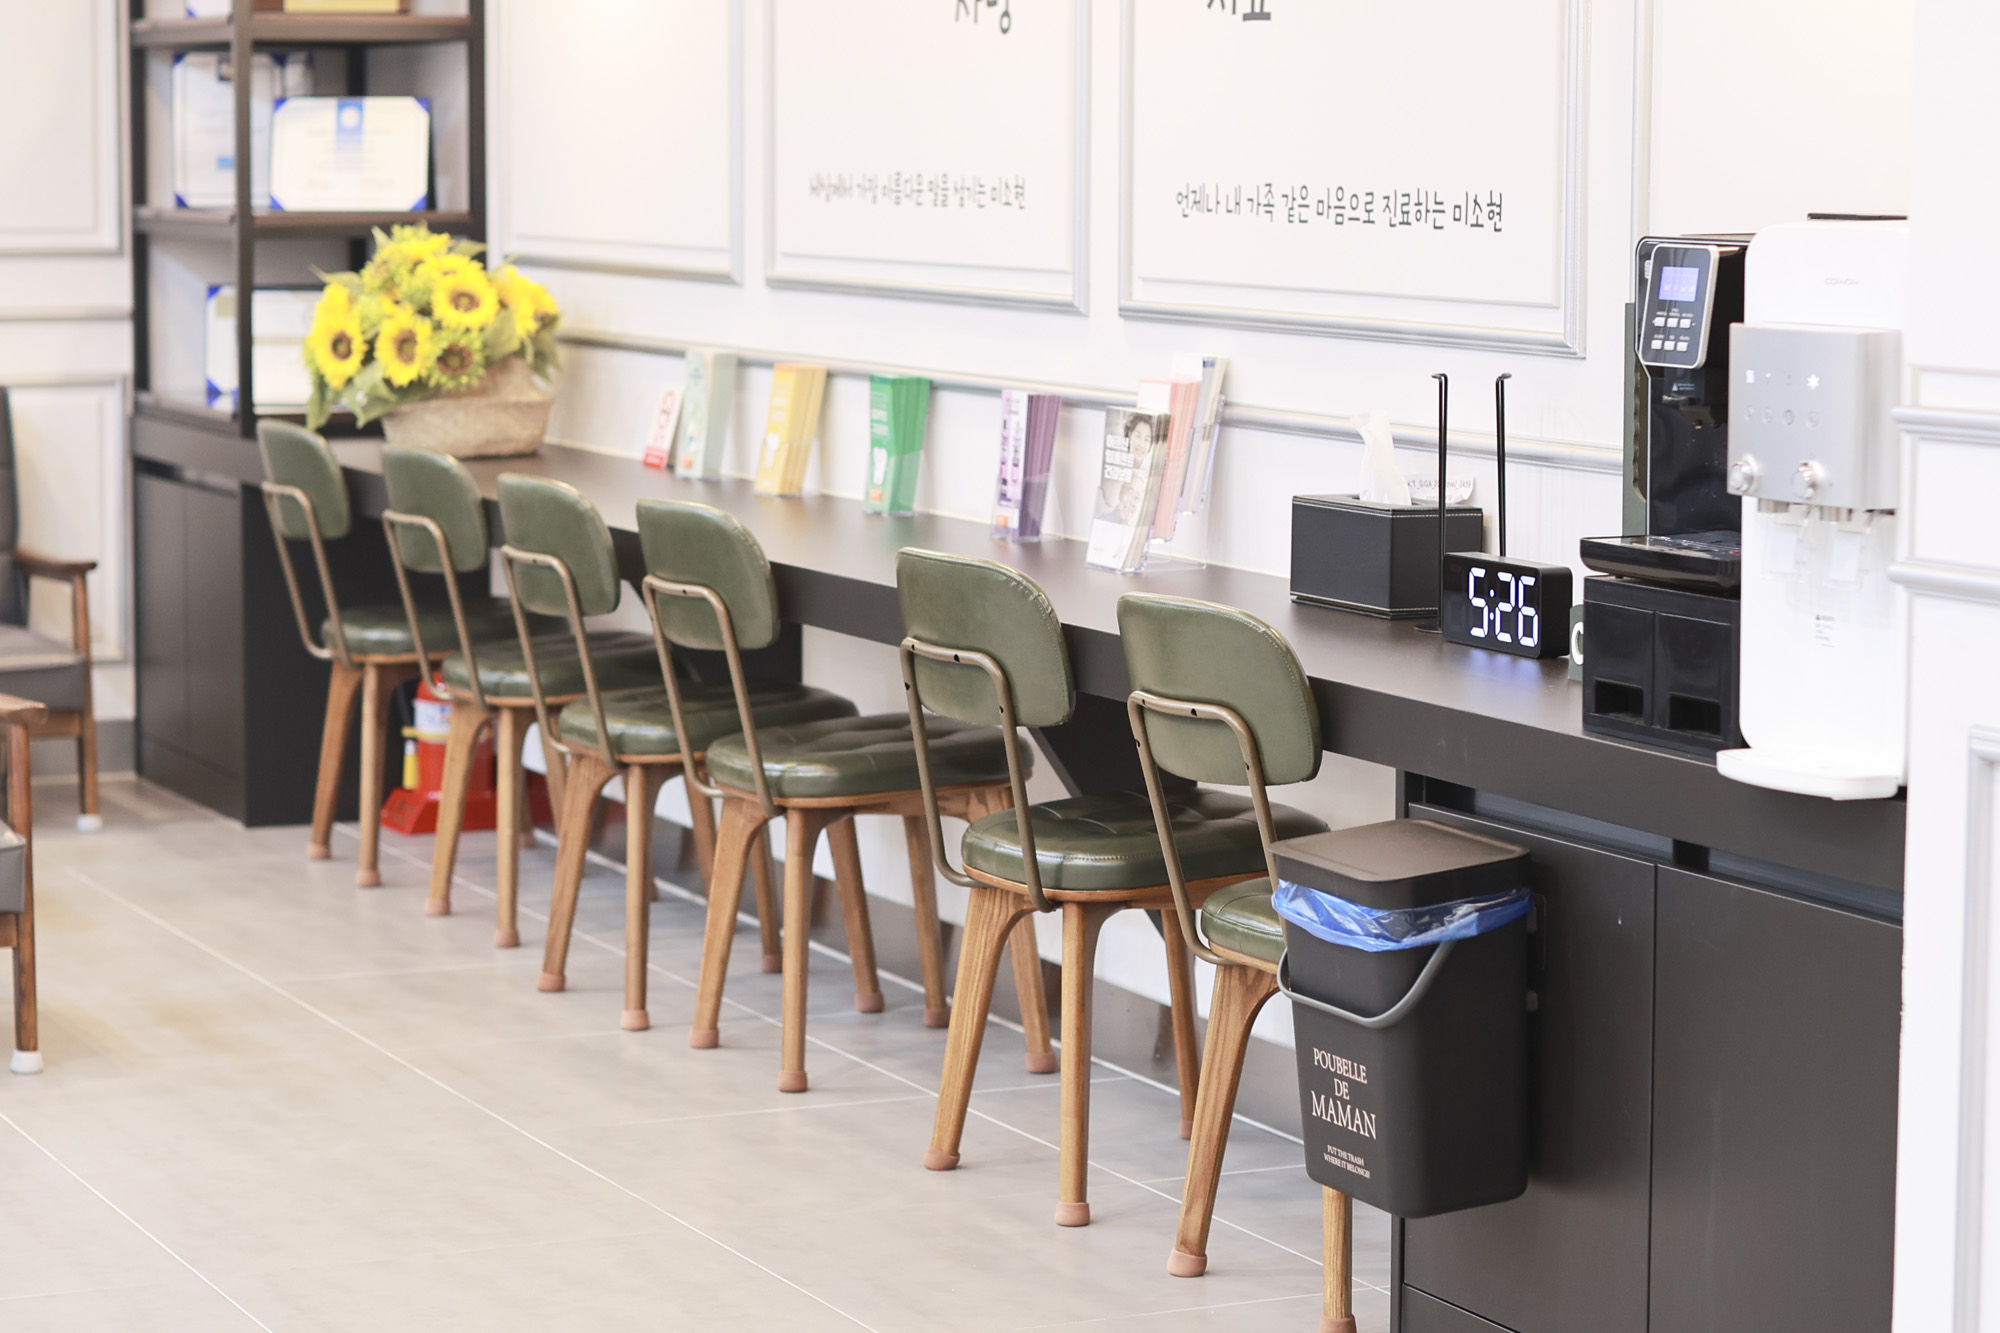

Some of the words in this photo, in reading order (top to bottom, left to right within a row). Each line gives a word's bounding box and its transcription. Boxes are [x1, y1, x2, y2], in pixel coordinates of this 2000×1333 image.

[882, 171, 924, 207] 아름다운
[991, 175, 1026, 210] 미소현
[1176, 182, 1220, 218] 언제나
[1226, 184, 1241, 215] 내
[1247, 182, 1275, 223] 가족
[1281, 184, 1310, 224] 같은
[1316, 185, 1376, 226] 마음으로
[1382, 187, 1446, 230] 진료하는
[1453, 189, 1503, 233] 미소현
[1468, 566, 1539, 648] 5:26
[1313, 1047, 1368, 1084] POUBELLE
[1334, 1077, 1350, 1100] DE
[1311, 1090, 1377, 1140] MAMAN
